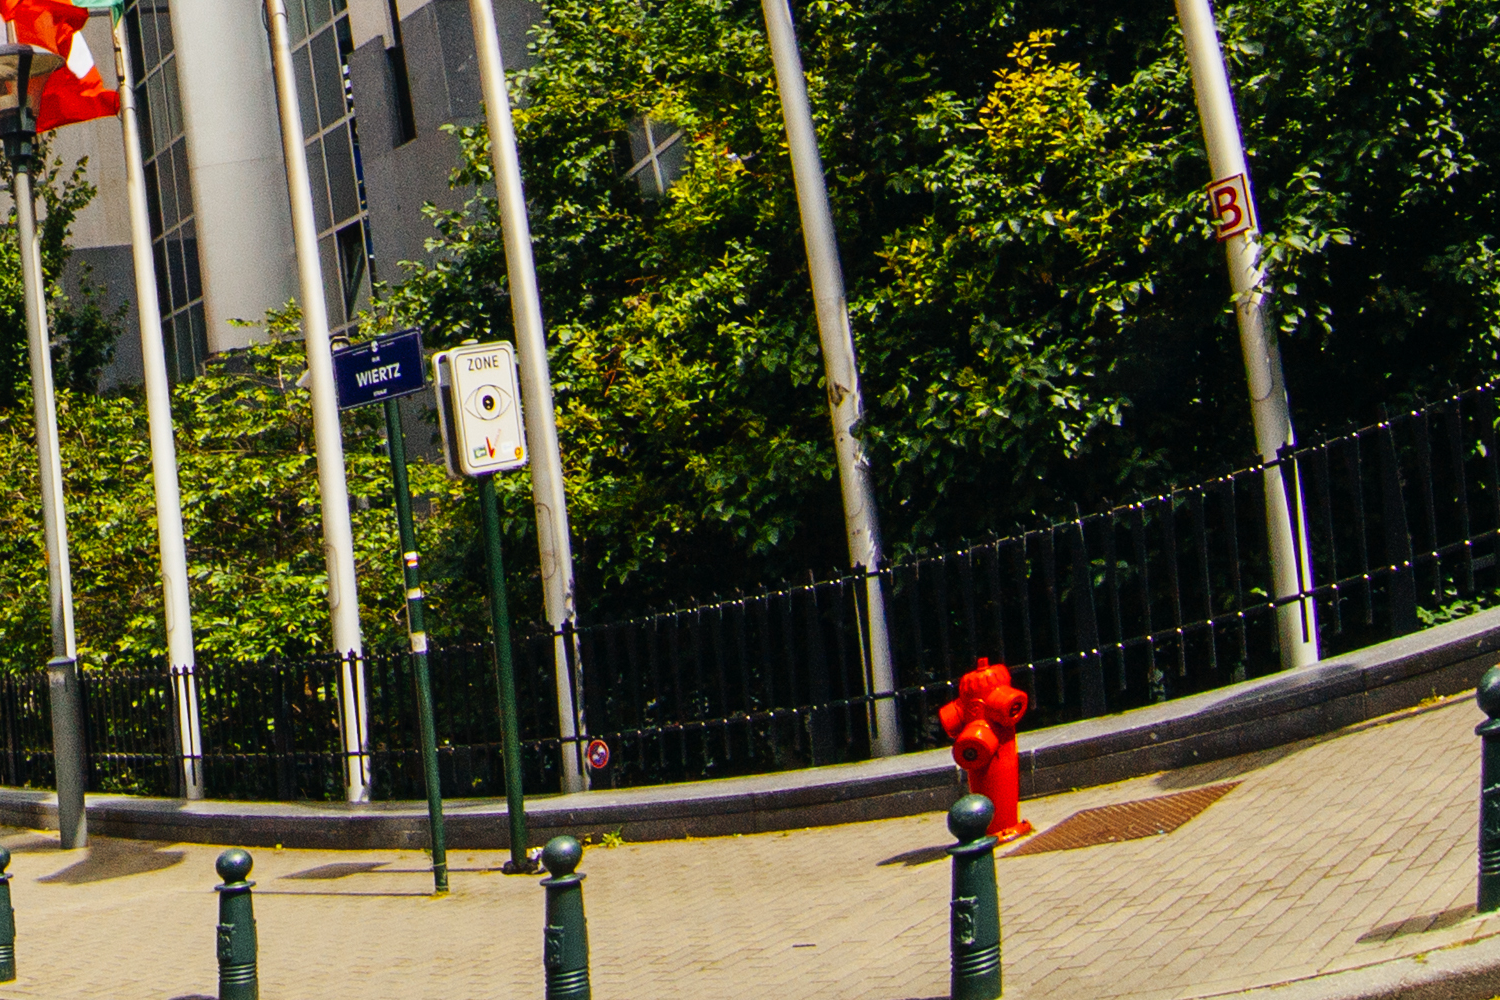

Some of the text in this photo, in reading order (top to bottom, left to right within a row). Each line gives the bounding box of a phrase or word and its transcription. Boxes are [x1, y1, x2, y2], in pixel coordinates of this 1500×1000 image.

[1213, 186, 1242, 232] B
[356, 363, 401, 387] WIERTZ
[467, 355, 499, 371] ZONE
